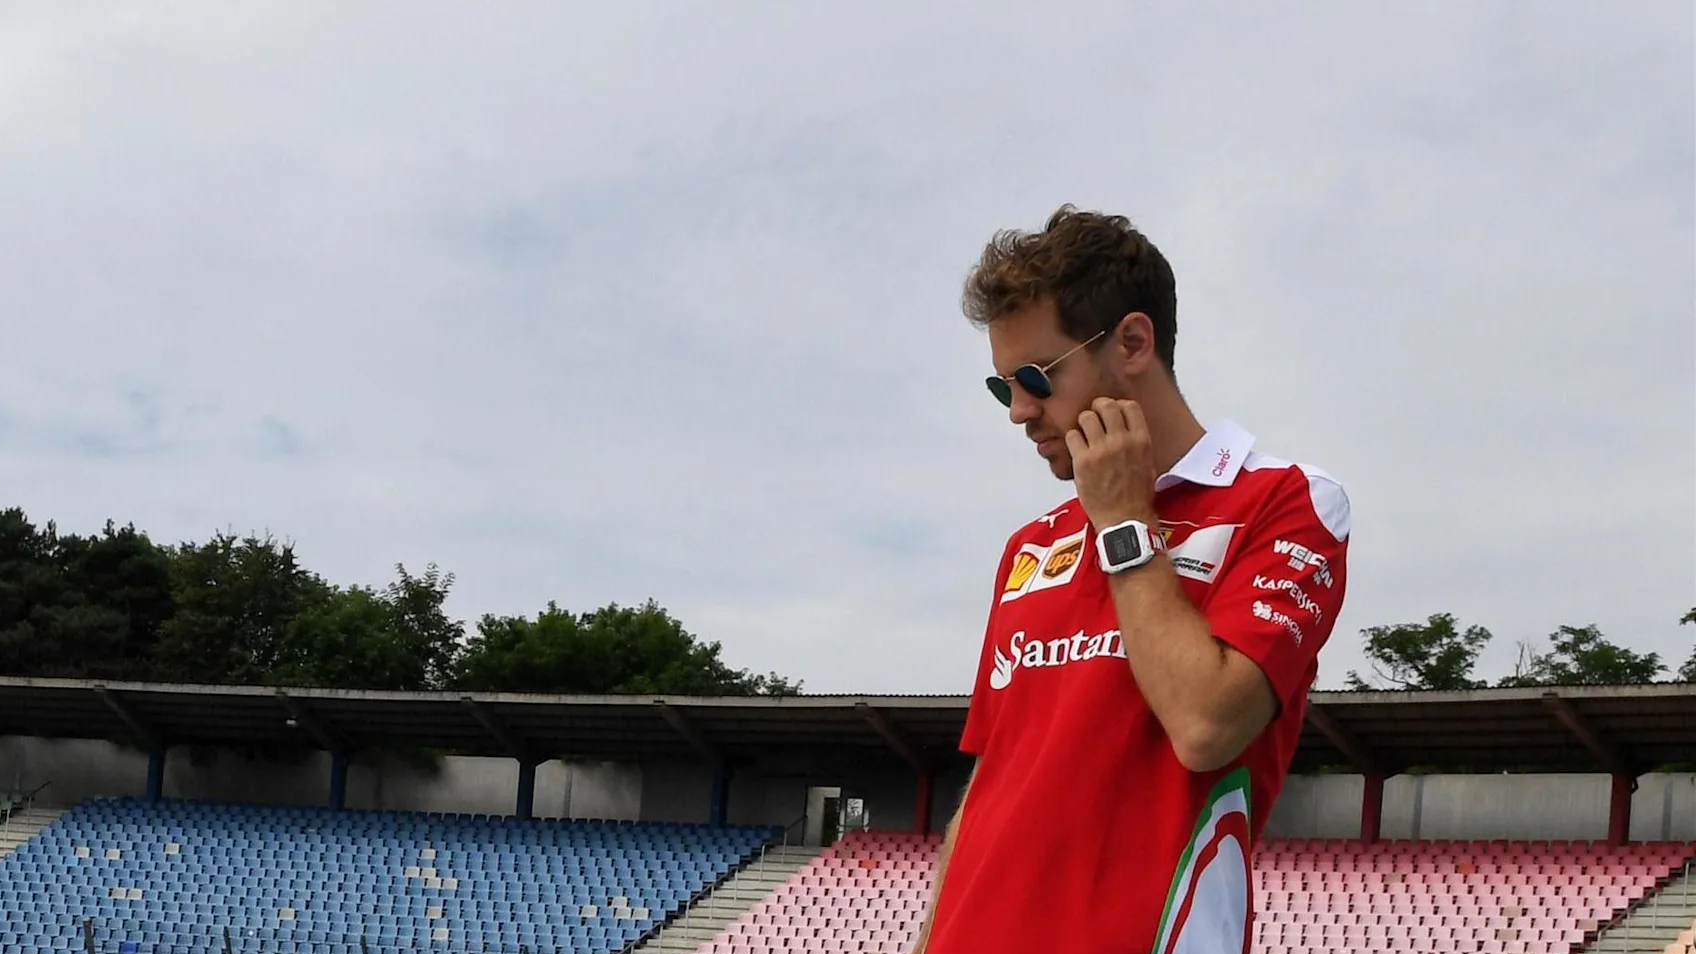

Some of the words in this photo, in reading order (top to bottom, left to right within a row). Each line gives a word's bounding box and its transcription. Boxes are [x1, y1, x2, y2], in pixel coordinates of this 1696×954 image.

[1212, 447, 1230, 477] Claro
[1046, 549, 1080, 573] ups
[1010, 629, 1127, 672] Santan
